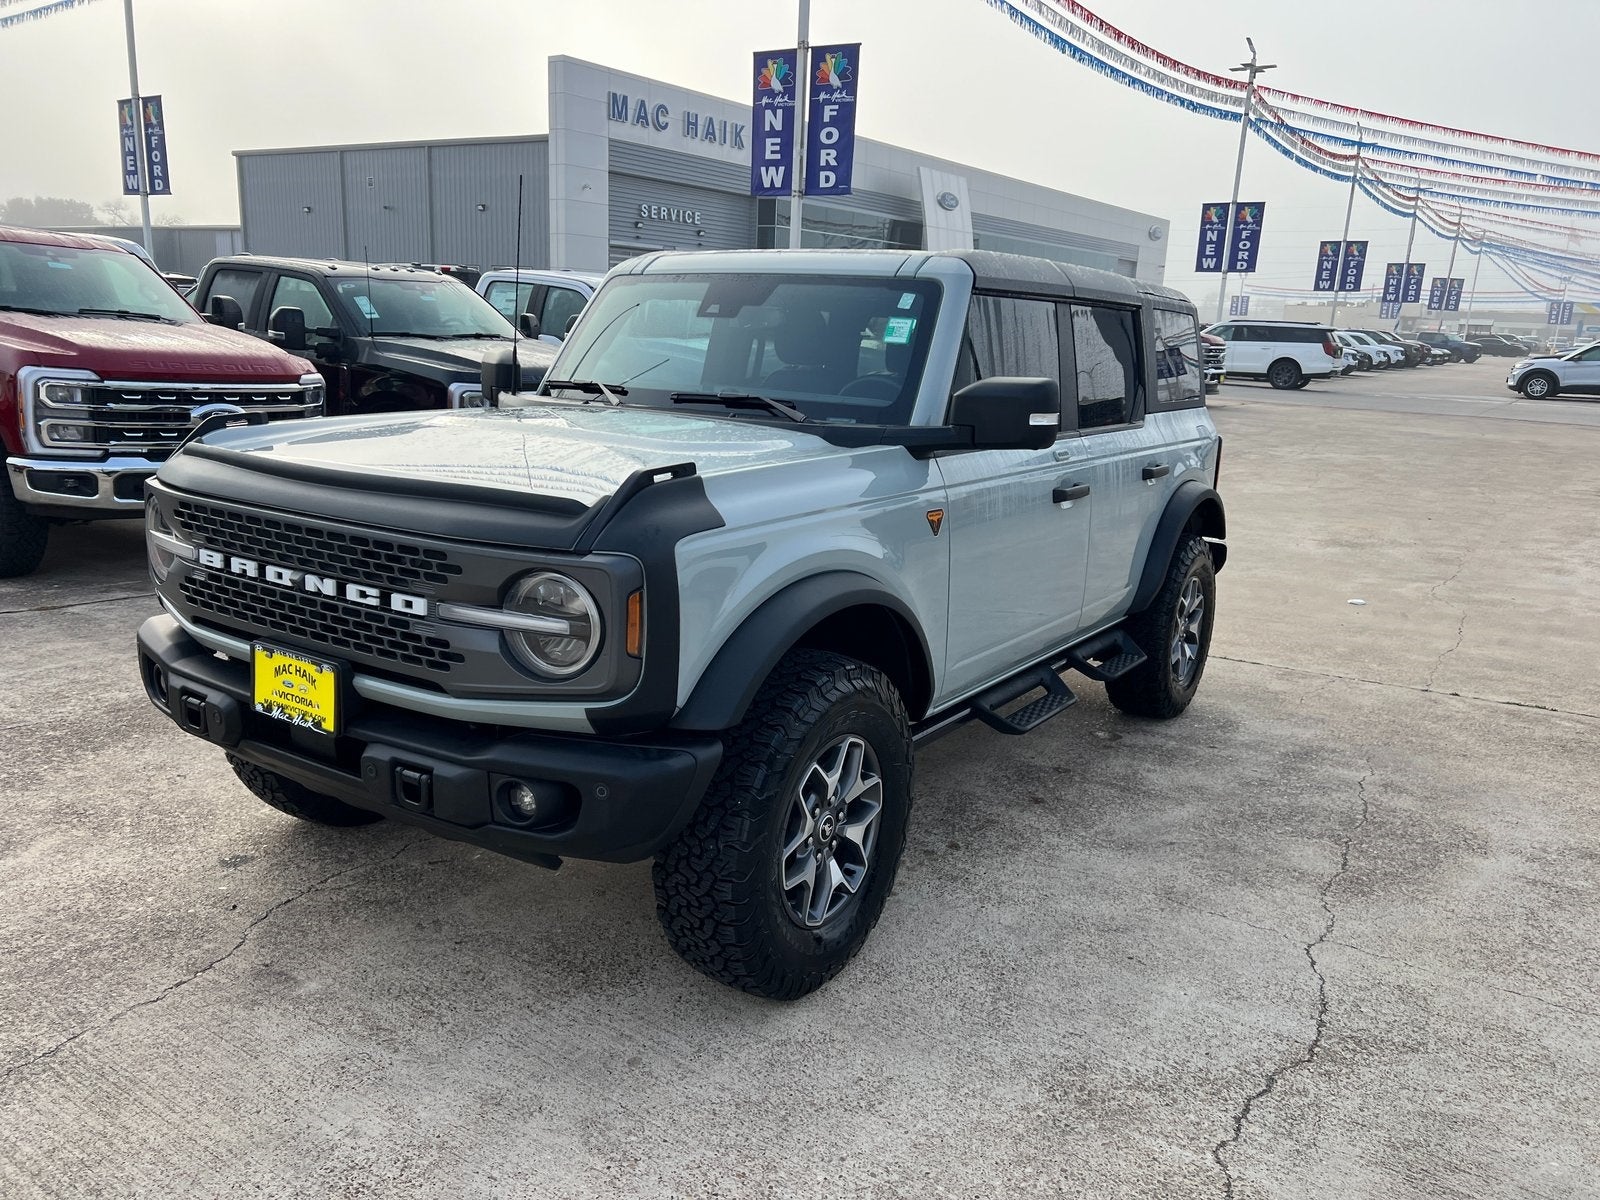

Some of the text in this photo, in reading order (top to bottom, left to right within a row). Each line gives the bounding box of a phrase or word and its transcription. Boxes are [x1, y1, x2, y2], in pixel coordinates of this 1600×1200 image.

[608, 91, 747, 149] MAC HAIK
[760, 108, 786, 189] NEW
[819, 104, 840, 188] FORD
[125, 137, 138, 190] NEW
[151, 137, 163, 190] FORD
[640, 203, 701, 225] SERVICE
[1202, 230, 1218, 269] NEW
[1236, 230, 1252, 270] FORD
[1319, 261, 1332, 289] NEW
[1345, 261, 1358, 290] FORD
[1386, 278, 1397, 301] NEW
[1407, 278, 1418, 302] FORD
[1431, 290, 1441, 309] NEW
[1448, 290, 1458, 310] FORD
[128, 360, 279, 373] SUPER DUTY
[199, 548, 428, 616] BRONCO
[274, 664, 293, 678] MAC
[294, 664, 317, 690] HAIK
[277, 689, 314, 709] VICTORIA
[269, 705, 320, 731] Mac Haik
